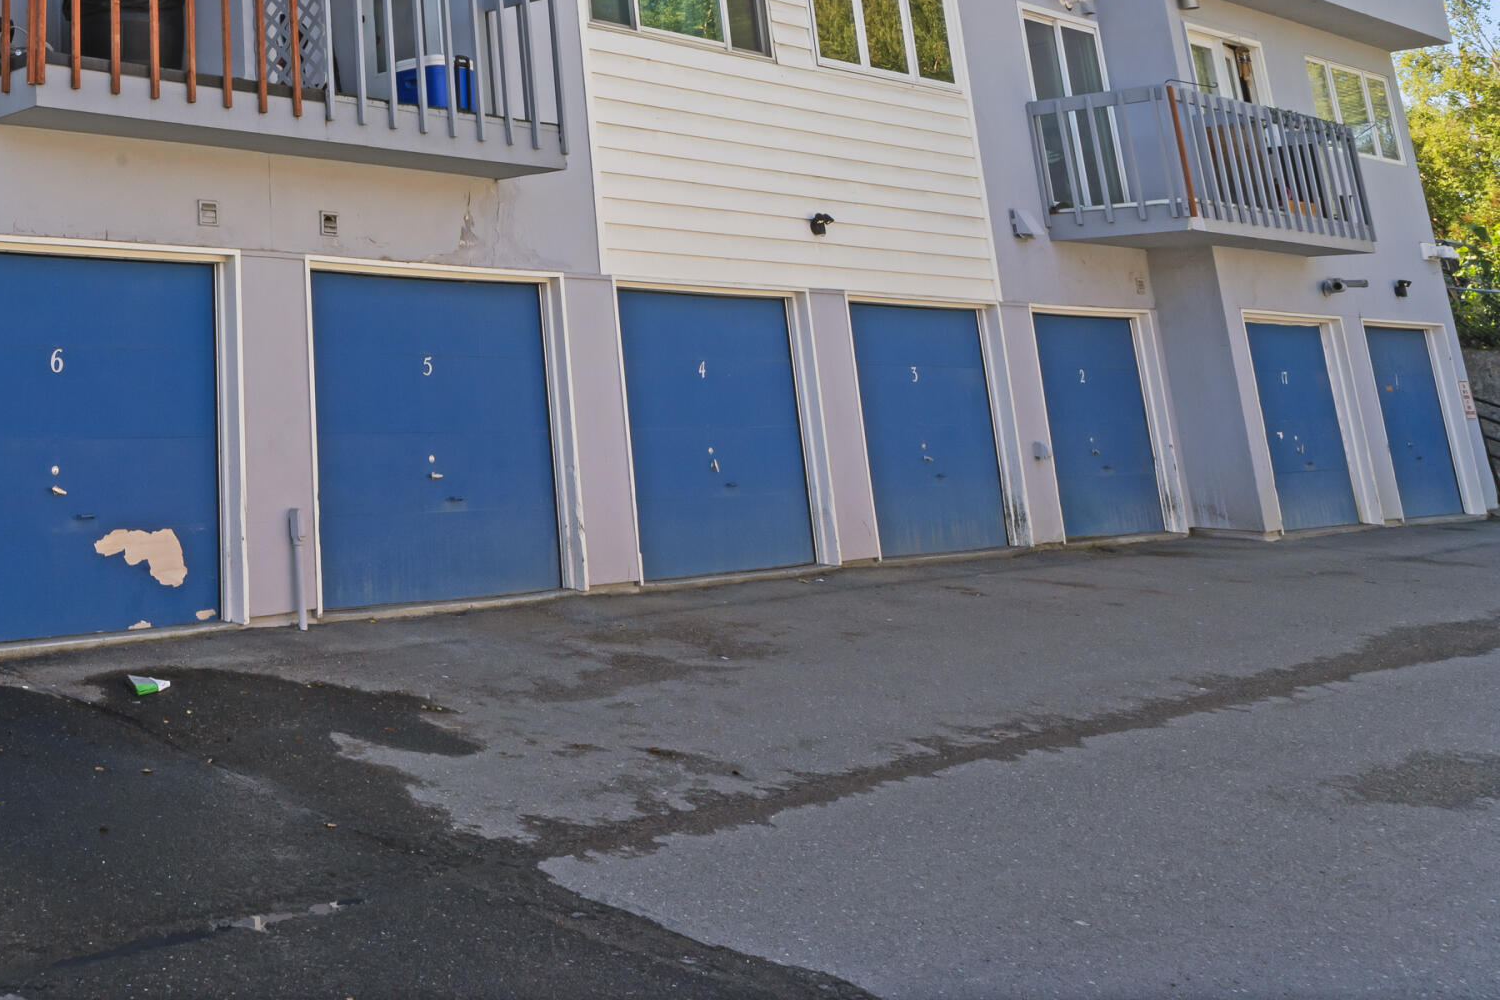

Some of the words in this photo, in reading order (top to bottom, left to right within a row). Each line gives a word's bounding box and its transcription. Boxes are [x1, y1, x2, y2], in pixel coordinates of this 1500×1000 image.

[50, 348, 64, 373] 6
[422, 356, 433, 376] 5
[698, 360, 706, 379] 4
[910, 366, 919, 383] 3
[1079, 368, 1086, 384] 2
